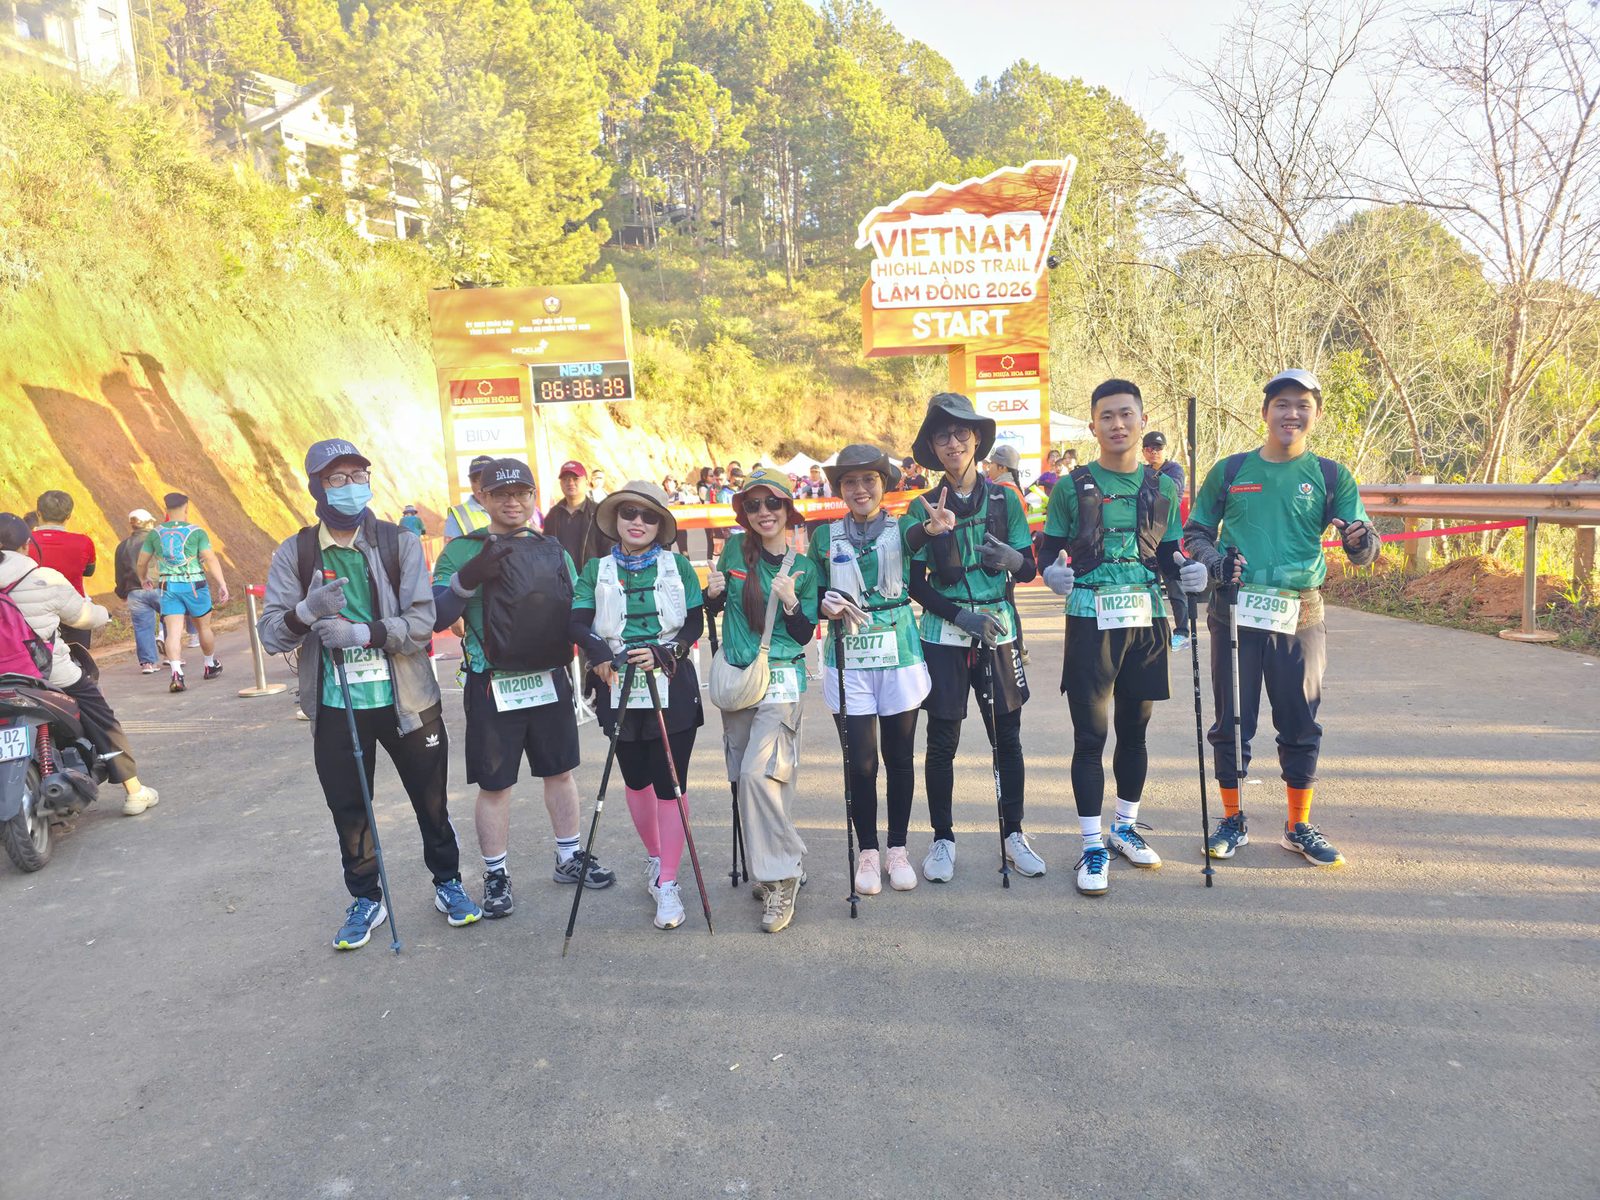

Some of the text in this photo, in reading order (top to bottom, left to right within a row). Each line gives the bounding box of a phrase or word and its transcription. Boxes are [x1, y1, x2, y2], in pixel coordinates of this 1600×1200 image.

[875, 223, 1032, 257] VIETNAM
[877, 258, 1031, 278] HIGHLANDS TRAIL
[877, 276, 1033, 303] LÂM ĐỒNG 2026
[912, 309, 1010, 340] START
[559, 363, 603, 377] NEXUS
[541, 377, 625, 400] 06:36:39
[491, 394, 519, 404] HOME
[988, 399, 1029, 413] GELEX
[466, 429, 500, 442] BIDV
[1245, 594, 1288, 614] F2399
[845, 634, 884, 651] F2077
[498, 674, 544, 695] M2008
